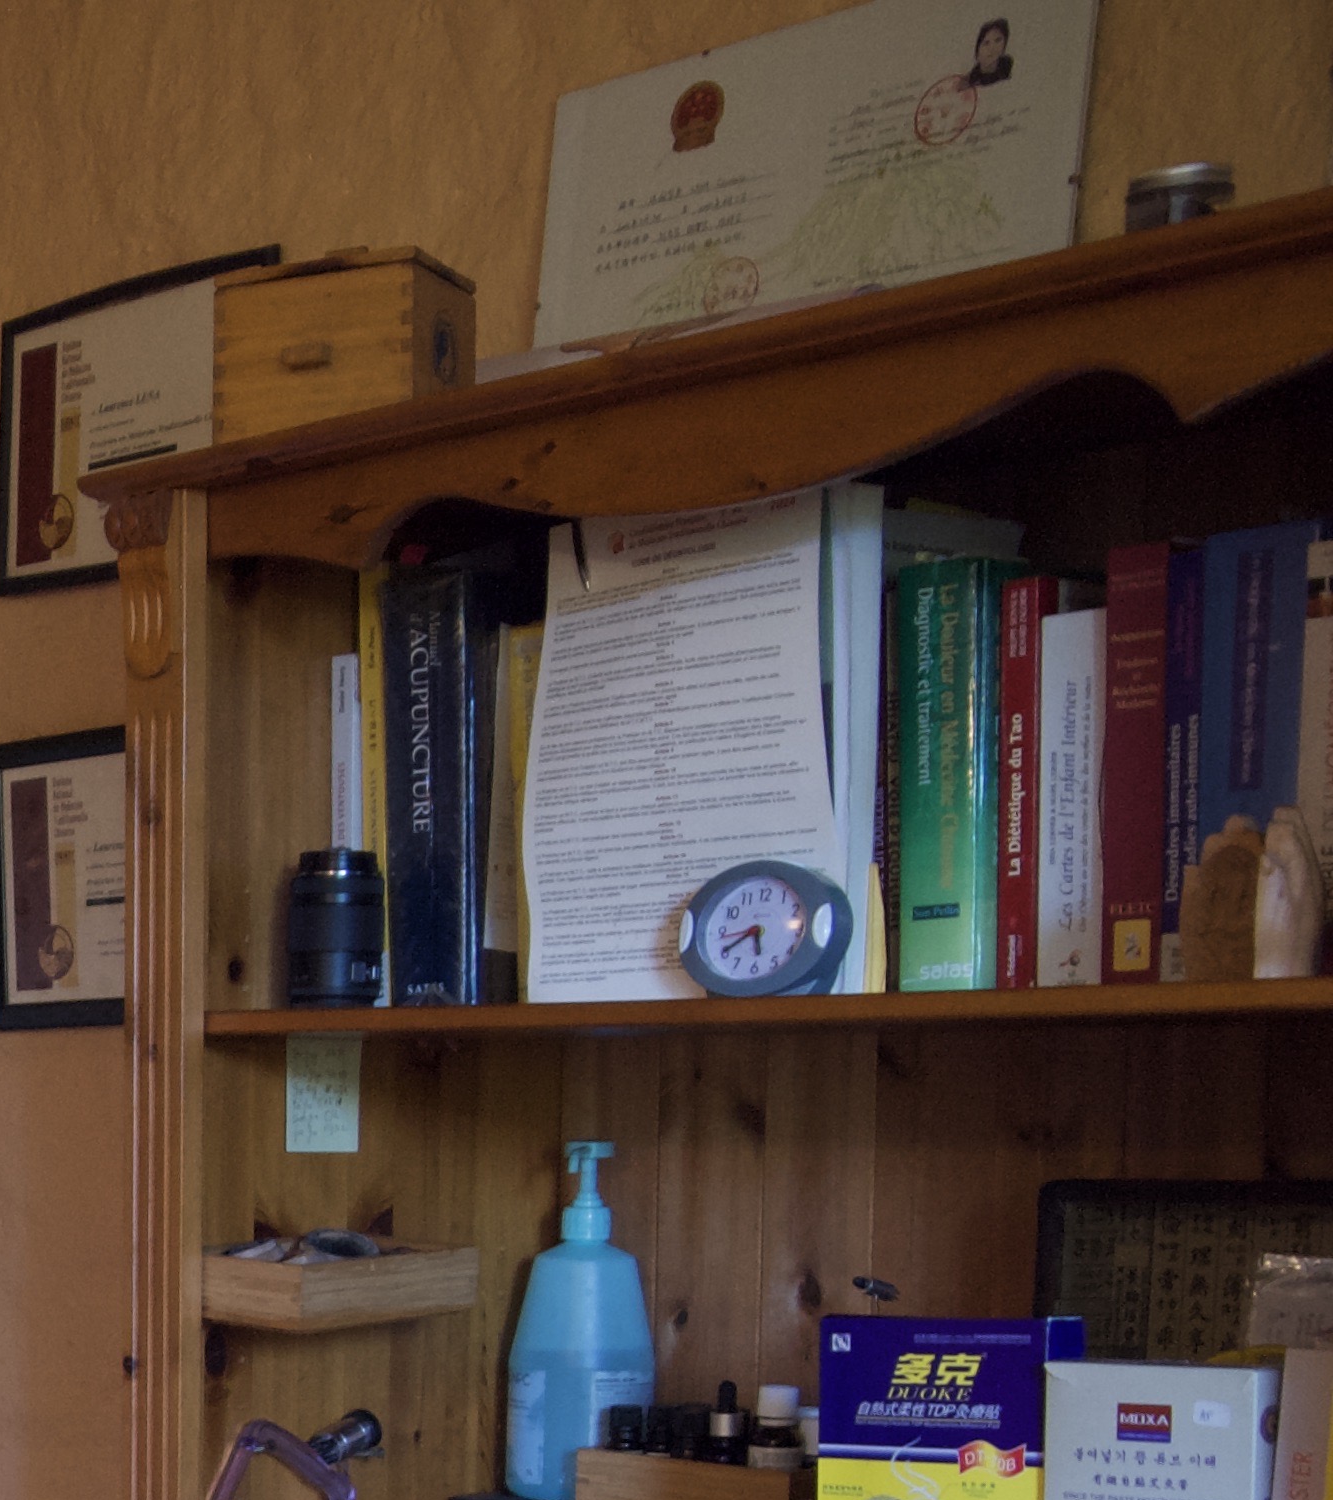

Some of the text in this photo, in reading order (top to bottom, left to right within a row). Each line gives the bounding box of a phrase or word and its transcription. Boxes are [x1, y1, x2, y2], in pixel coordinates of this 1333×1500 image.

[939, 584, 958, 605] La
[429, 611, 442, 667] Manuel
[939, 611, 958, 683] Douleur
[915, 588, 933, 785] Diagnostic et traitement
[940, 691, 955, 712] en
[1059, 680, 1077, 746] Intérieur
[1186, 714, 1199, 820] auto-immunes
[337, 762, 345, 819] VENTOUSES
[1008, 713, 1025, 876] La Diététique du Tao
[1165, 724, 1181, 902] Désordres immunitaires
[1059, 823, 1073, 840] de
[1059, 847, 1074, 895] Cartes
[741, 892, 753, 905] 11
[759, 888, 772, 902] 12
[781, 890, 786, 904] 1
[727, 906, 739, 920] 10
[792, 904, 799, 916] 2
[1059, 902, 1073, 931] Les
[733, 957, 741, 970] 7
[750, 961, 759, 974] 6
[769, 956, 779, 970] 5
[919, 962, 974, 981] satas
[891, 1353, 981, 1386] 多克
[887, 1386, 973, 1402] DUOKE
